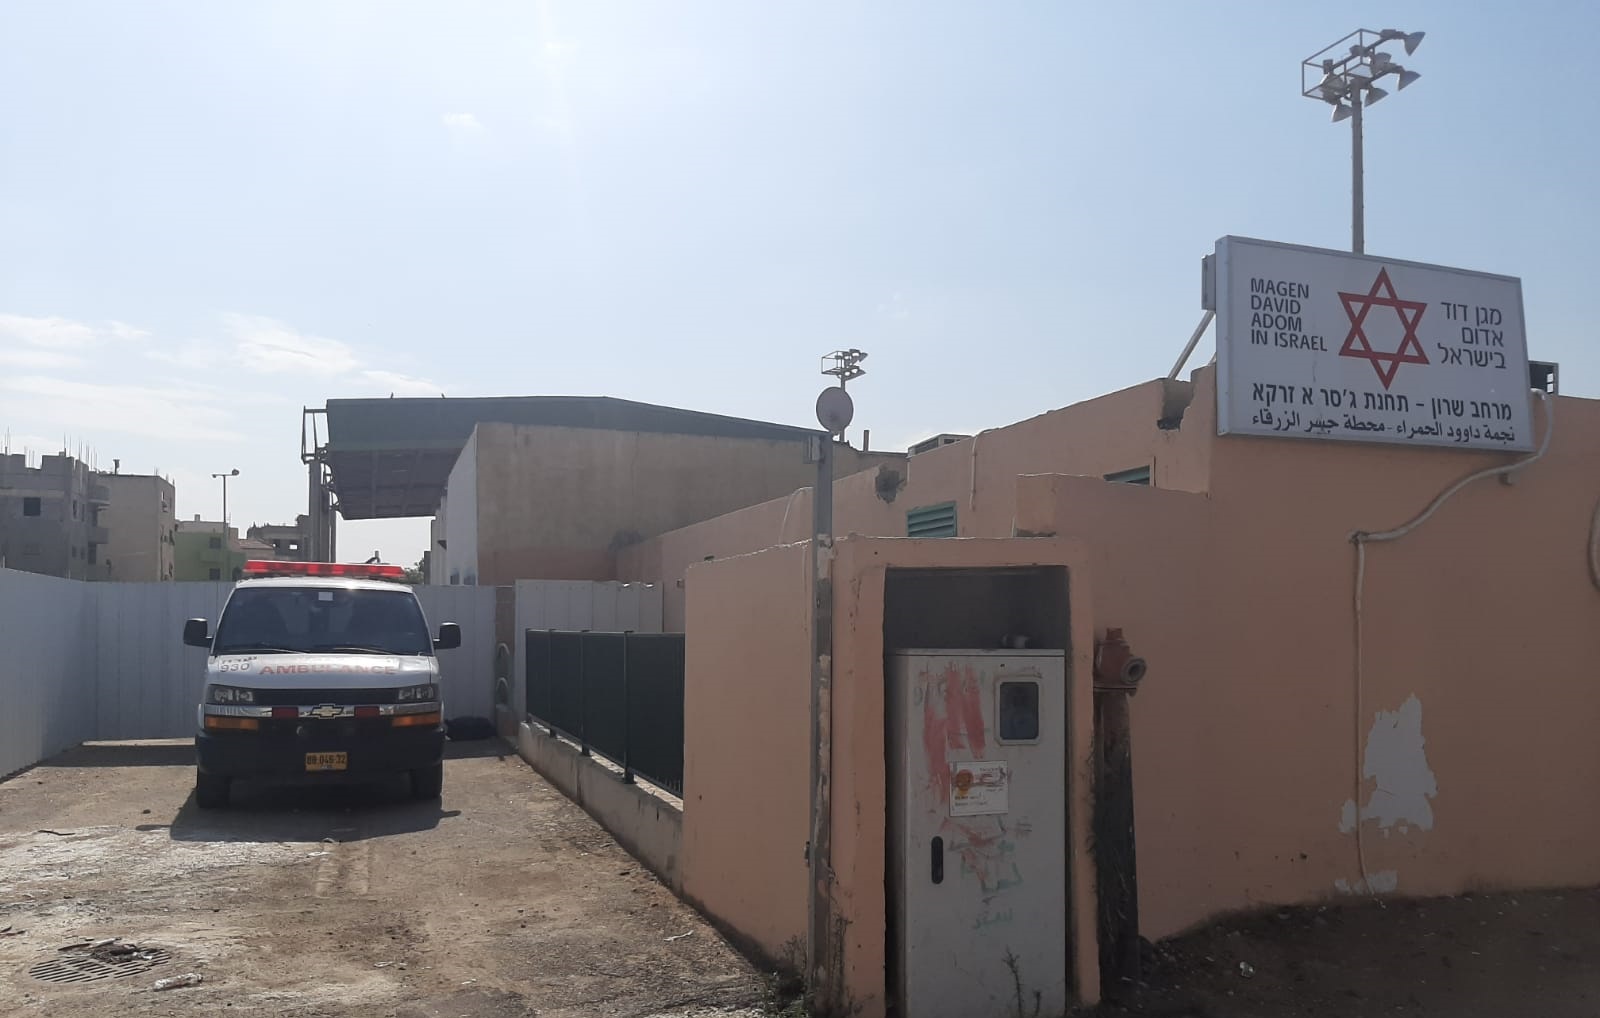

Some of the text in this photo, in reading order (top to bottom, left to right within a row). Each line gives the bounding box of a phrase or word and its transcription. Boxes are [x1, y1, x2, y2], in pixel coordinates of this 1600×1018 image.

[1250, 277, 1310, 299] MAGEN
[1250, 295, 1301, 315] DAVID
[1440, 301, 1502, 326] מגן דוד
[1251, 313, 1302, 333] ADOM
[1251, 329, 1328, 352] IN ISRAEL
[1461, 327, 1504, 347] אדום
[1437, 343, 1506, 369] בישראל
[1252, 382, 1295, 407] זרקא
[1302, 386, 1314, 405] א
[1364, 391, 1409, 413] תחנת
[1431, 397, 1464, 420] שרון
[1470, 400, 1512, 421] מרחב
[1252, 408, 1300, 431] الزرقاء
[1304, 417, 1339, 434] جسر
[1343, 413, 1385, 432] محطة
[1396, 419, 1443, 439] الحمراء
[1447, 424, 1481, 443] داوود
[1484, 424, 1515, 445] نجمة
[219, 663, 397, 675] 930 AMBULANCE
